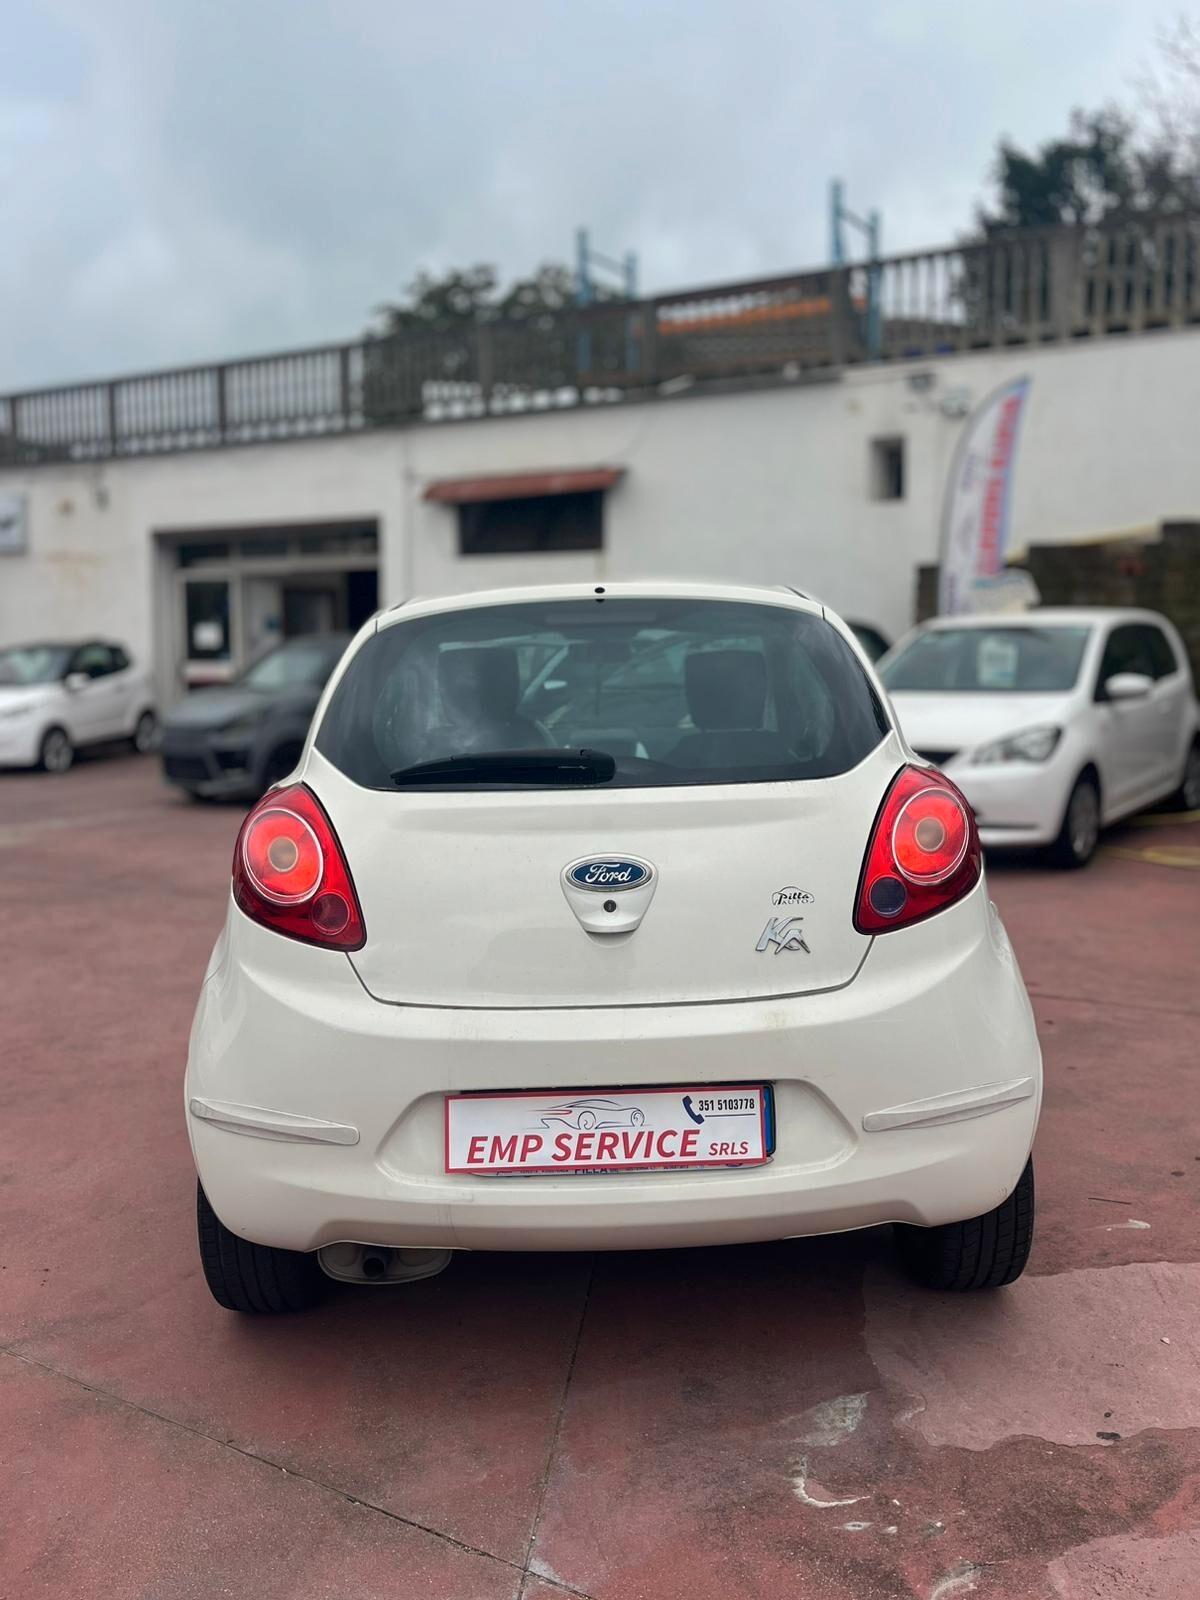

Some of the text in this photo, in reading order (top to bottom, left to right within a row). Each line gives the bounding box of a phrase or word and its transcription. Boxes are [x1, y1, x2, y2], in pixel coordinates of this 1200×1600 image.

[586, 863, 631, 883] Ford
[699, 1097, 755, 1111] 351 5103778
[467, 1130, 749, 1164] EMP SERVICE SRLS
